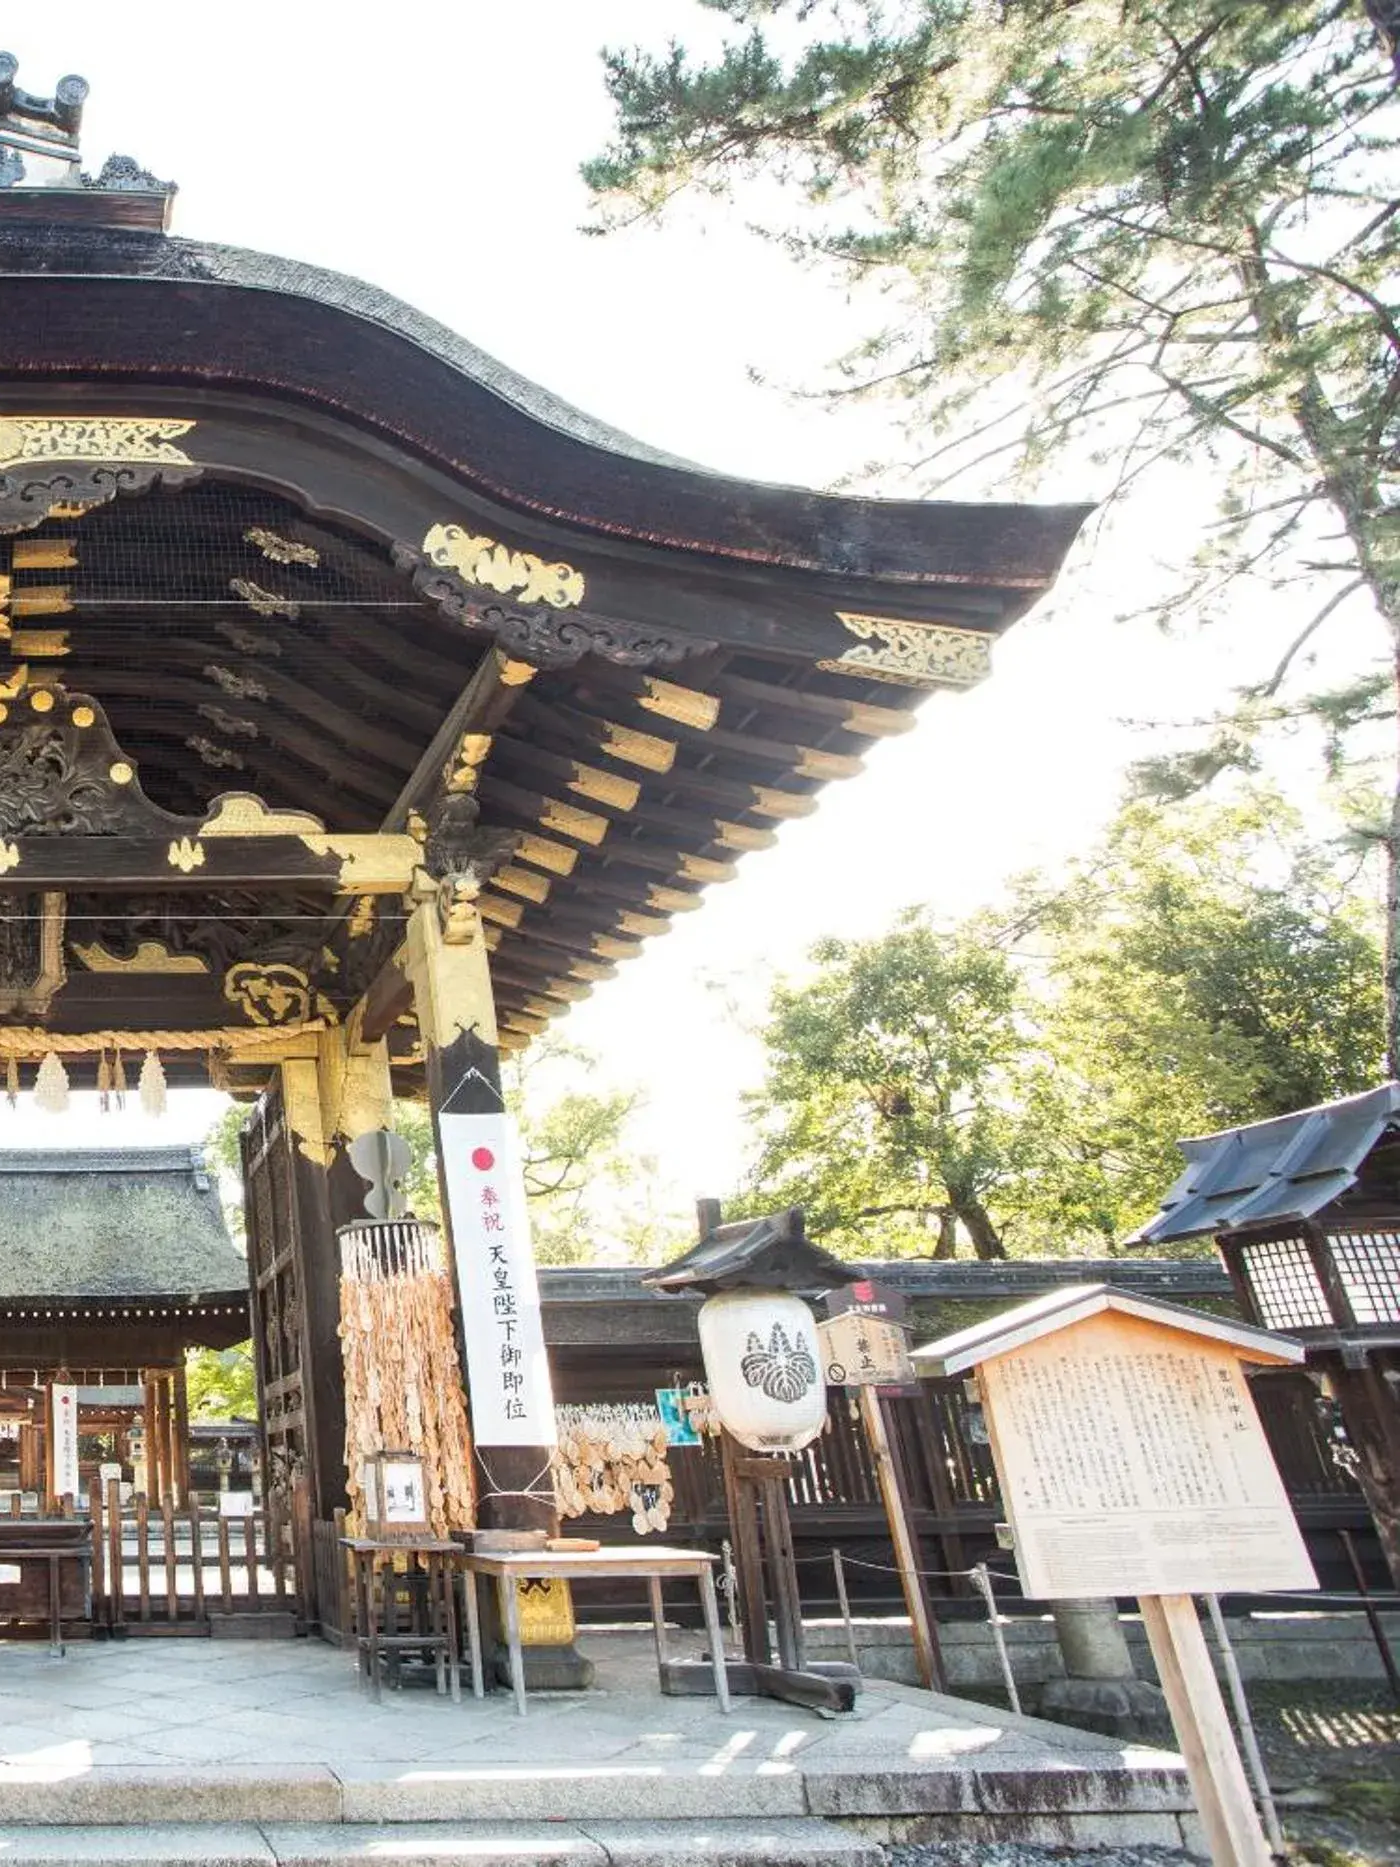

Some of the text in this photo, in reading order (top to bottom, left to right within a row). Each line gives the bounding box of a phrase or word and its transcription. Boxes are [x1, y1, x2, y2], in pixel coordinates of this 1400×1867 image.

[480, 1185, 528, 1420] 奉祝 天皇陛下御即位
